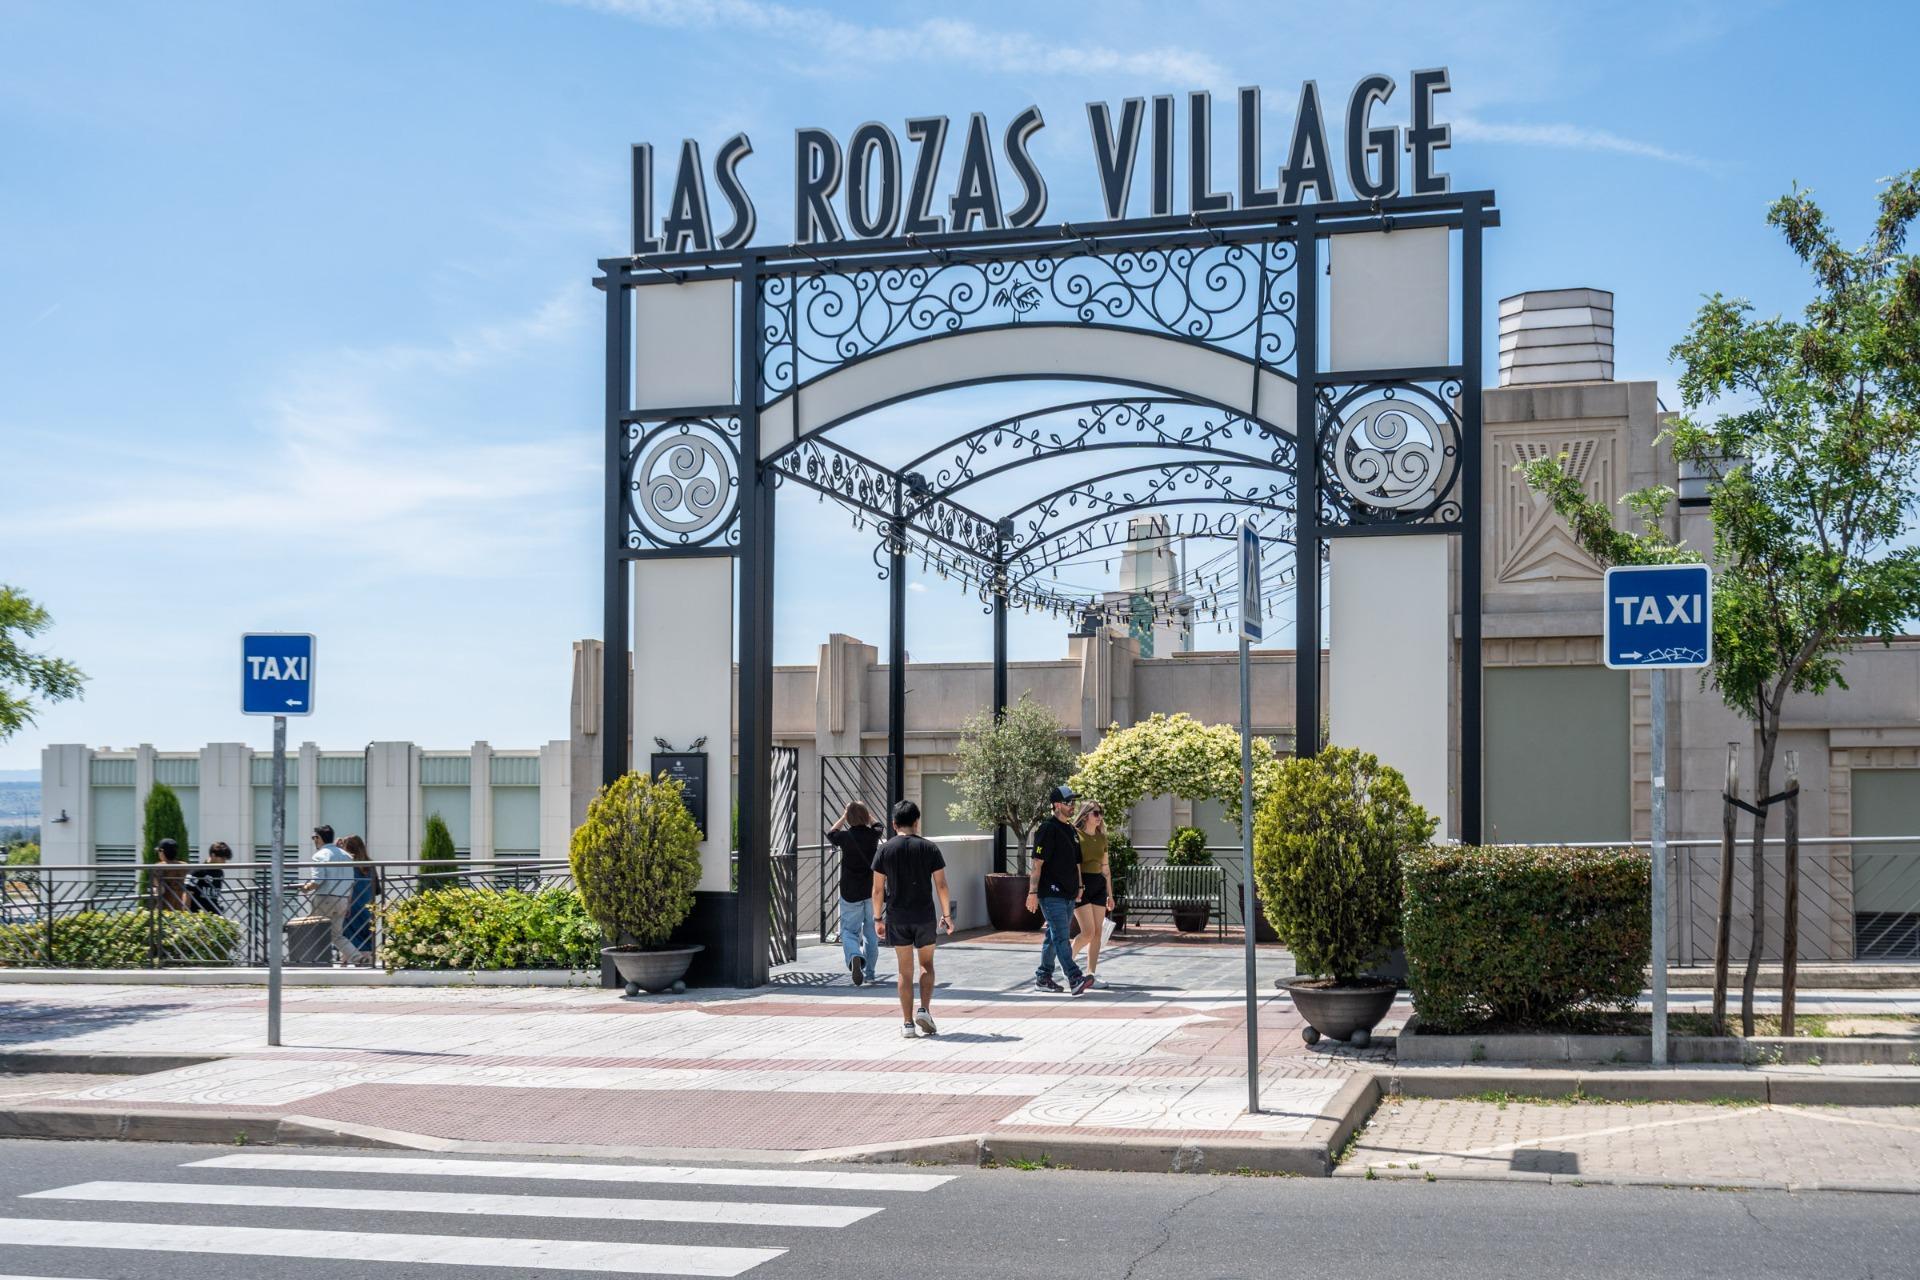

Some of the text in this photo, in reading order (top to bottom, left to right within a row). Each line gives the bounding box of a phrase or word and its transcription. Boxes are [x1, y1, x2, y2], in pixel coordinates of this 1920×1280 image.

[631, 67, 1451, 255] LAS ROZAS VILLAGE
[1020, 512, 1260, 577] BIENVENIDOS
[1614, 594, 1702, 626] TAXI
[247, 656, 308, 681] TAXI
